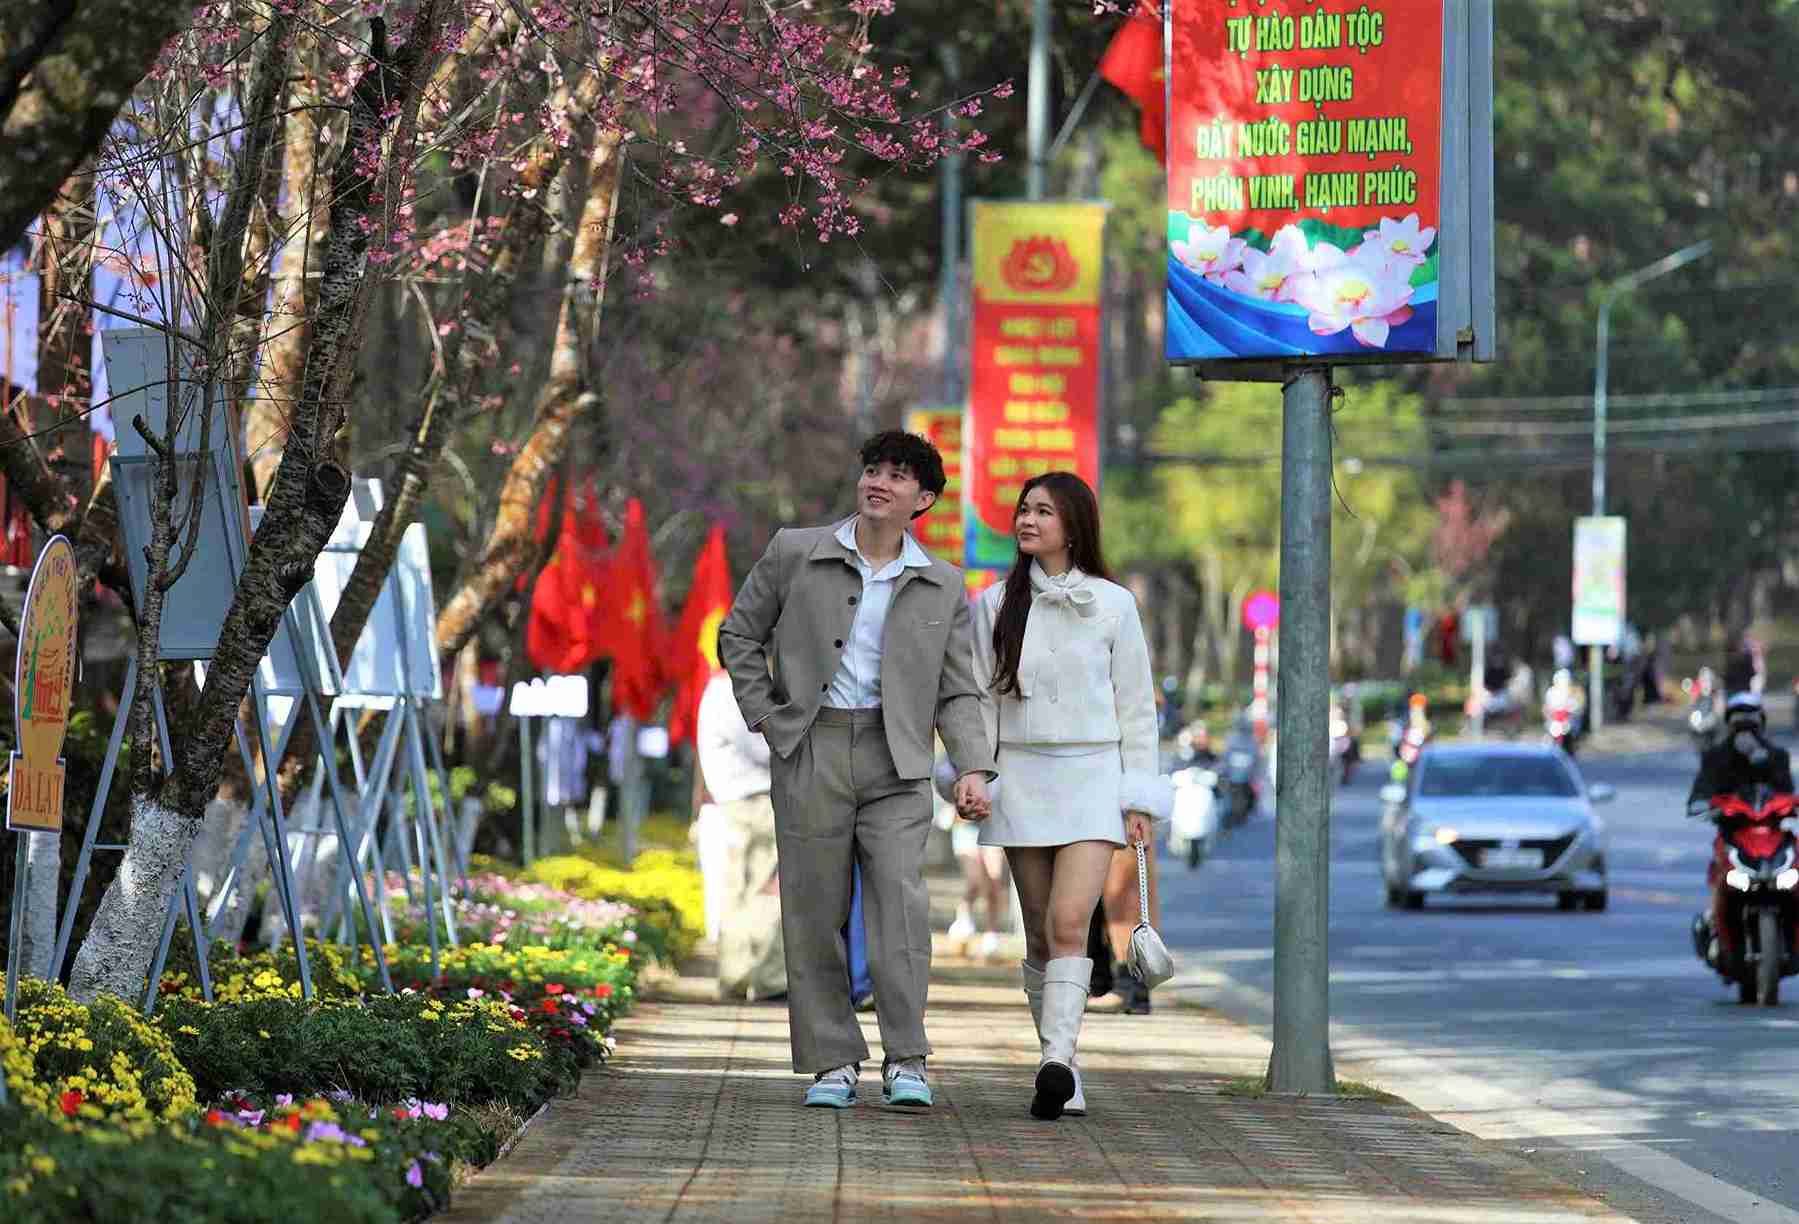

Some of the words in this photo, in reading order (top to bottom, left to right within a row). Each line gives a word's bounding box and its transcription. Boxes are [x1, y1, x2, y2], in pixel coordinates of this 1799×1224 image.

[1256, 10, 1294, 51] HÀO
[1300, 8, 1341, 49] DÂN
[1346, 6, 1384, 54] TỘC
[1255, 64, 1294, 104] XÂY
[1299, 65, 1353, 109] DỰNG
[1296, 114, 1342, 155] GIÀU
[1347, 117, 1413, 160] MẠNH,
[1249, 175, 1300, 212] VINH,
[1304, 172, 1359, 214] HẠNH
[1364, 165, 1417, 206] PHÚC
